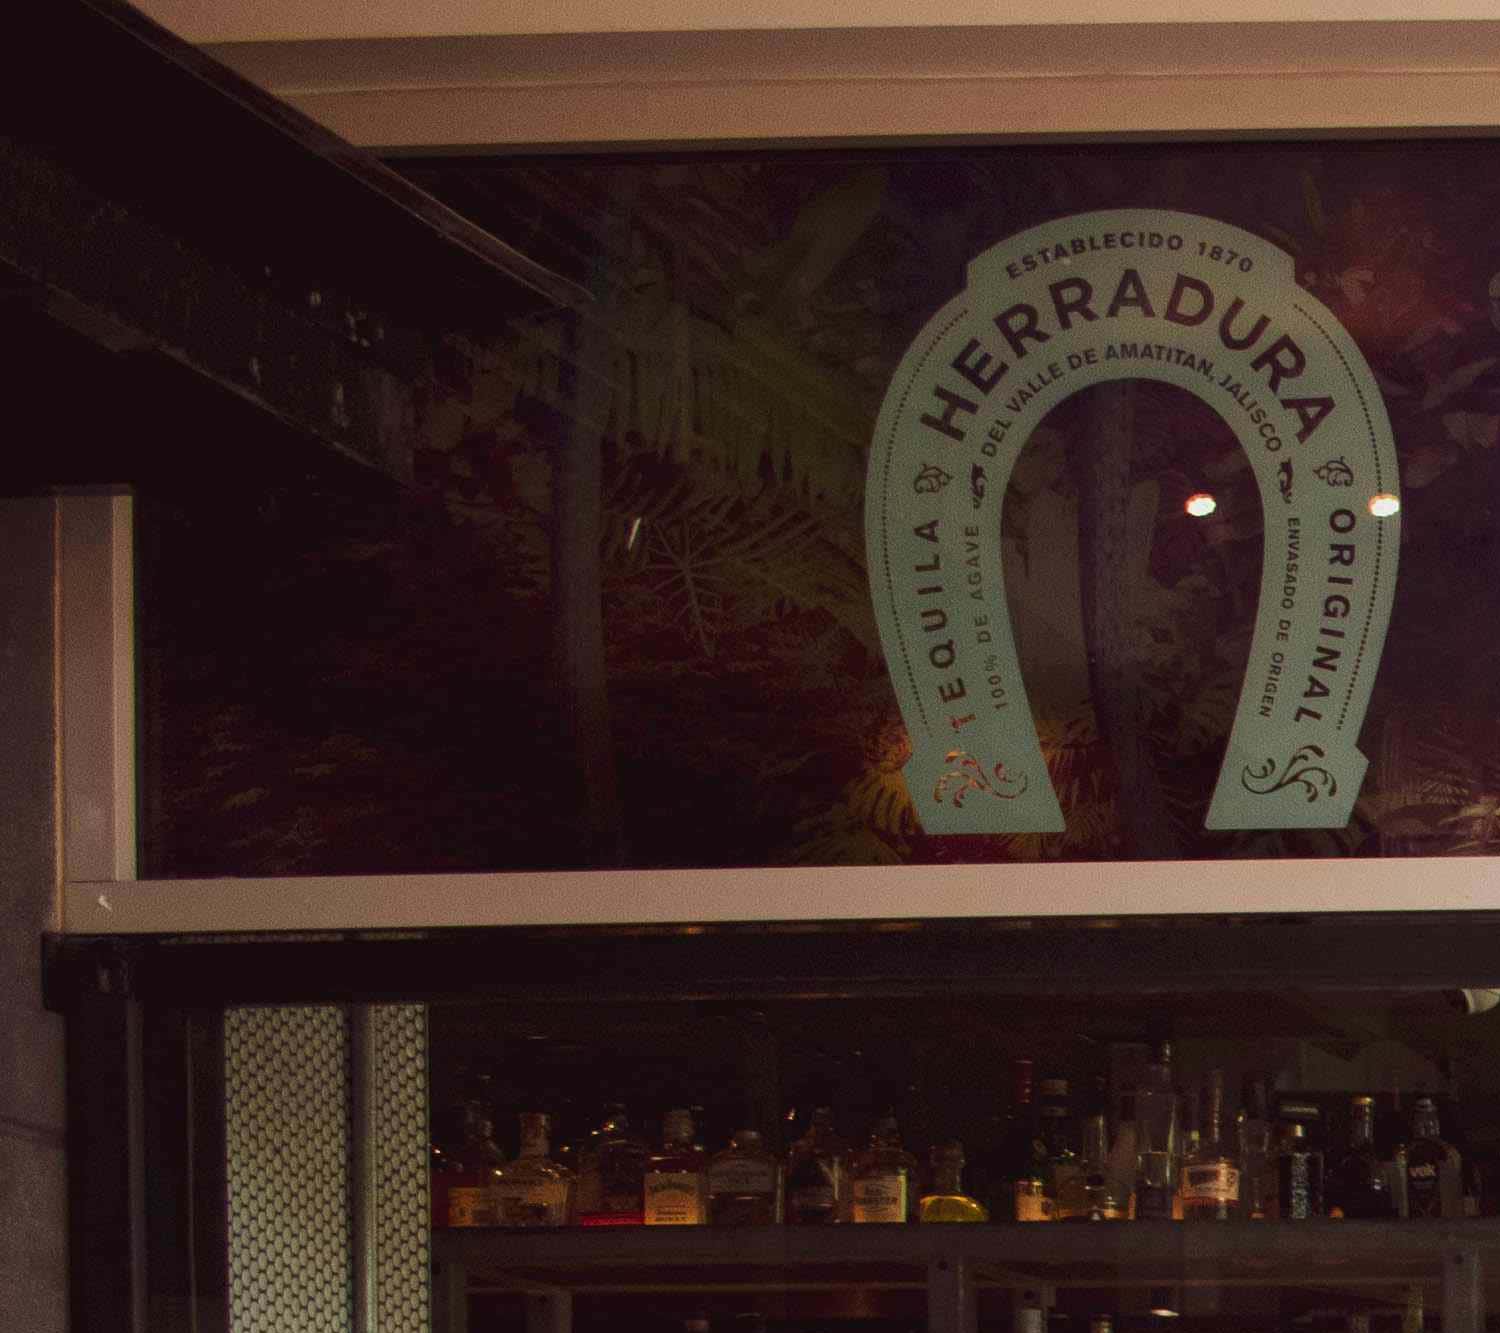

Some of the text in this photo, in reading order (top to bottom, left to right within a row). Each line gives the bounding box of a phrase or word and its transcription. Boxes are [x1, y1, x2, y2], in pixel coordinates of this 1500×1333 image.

[1006, 232, 1253, 280] ESTABLECIDO 1870
[919, 268, 1337, 445] HERRADURA
[981, 343, 1282, 458] DEL VALLE DE AMATITAN, JALISCO
[913, 519, 977, 733] TEQUILA
[964, 525, 1009, 712] 100% DE AGAVE
[1260, 517, 1300, 718] ENVASADO DE ORIGEN
[1294, 508, 1356, 723] ORIGINAL
